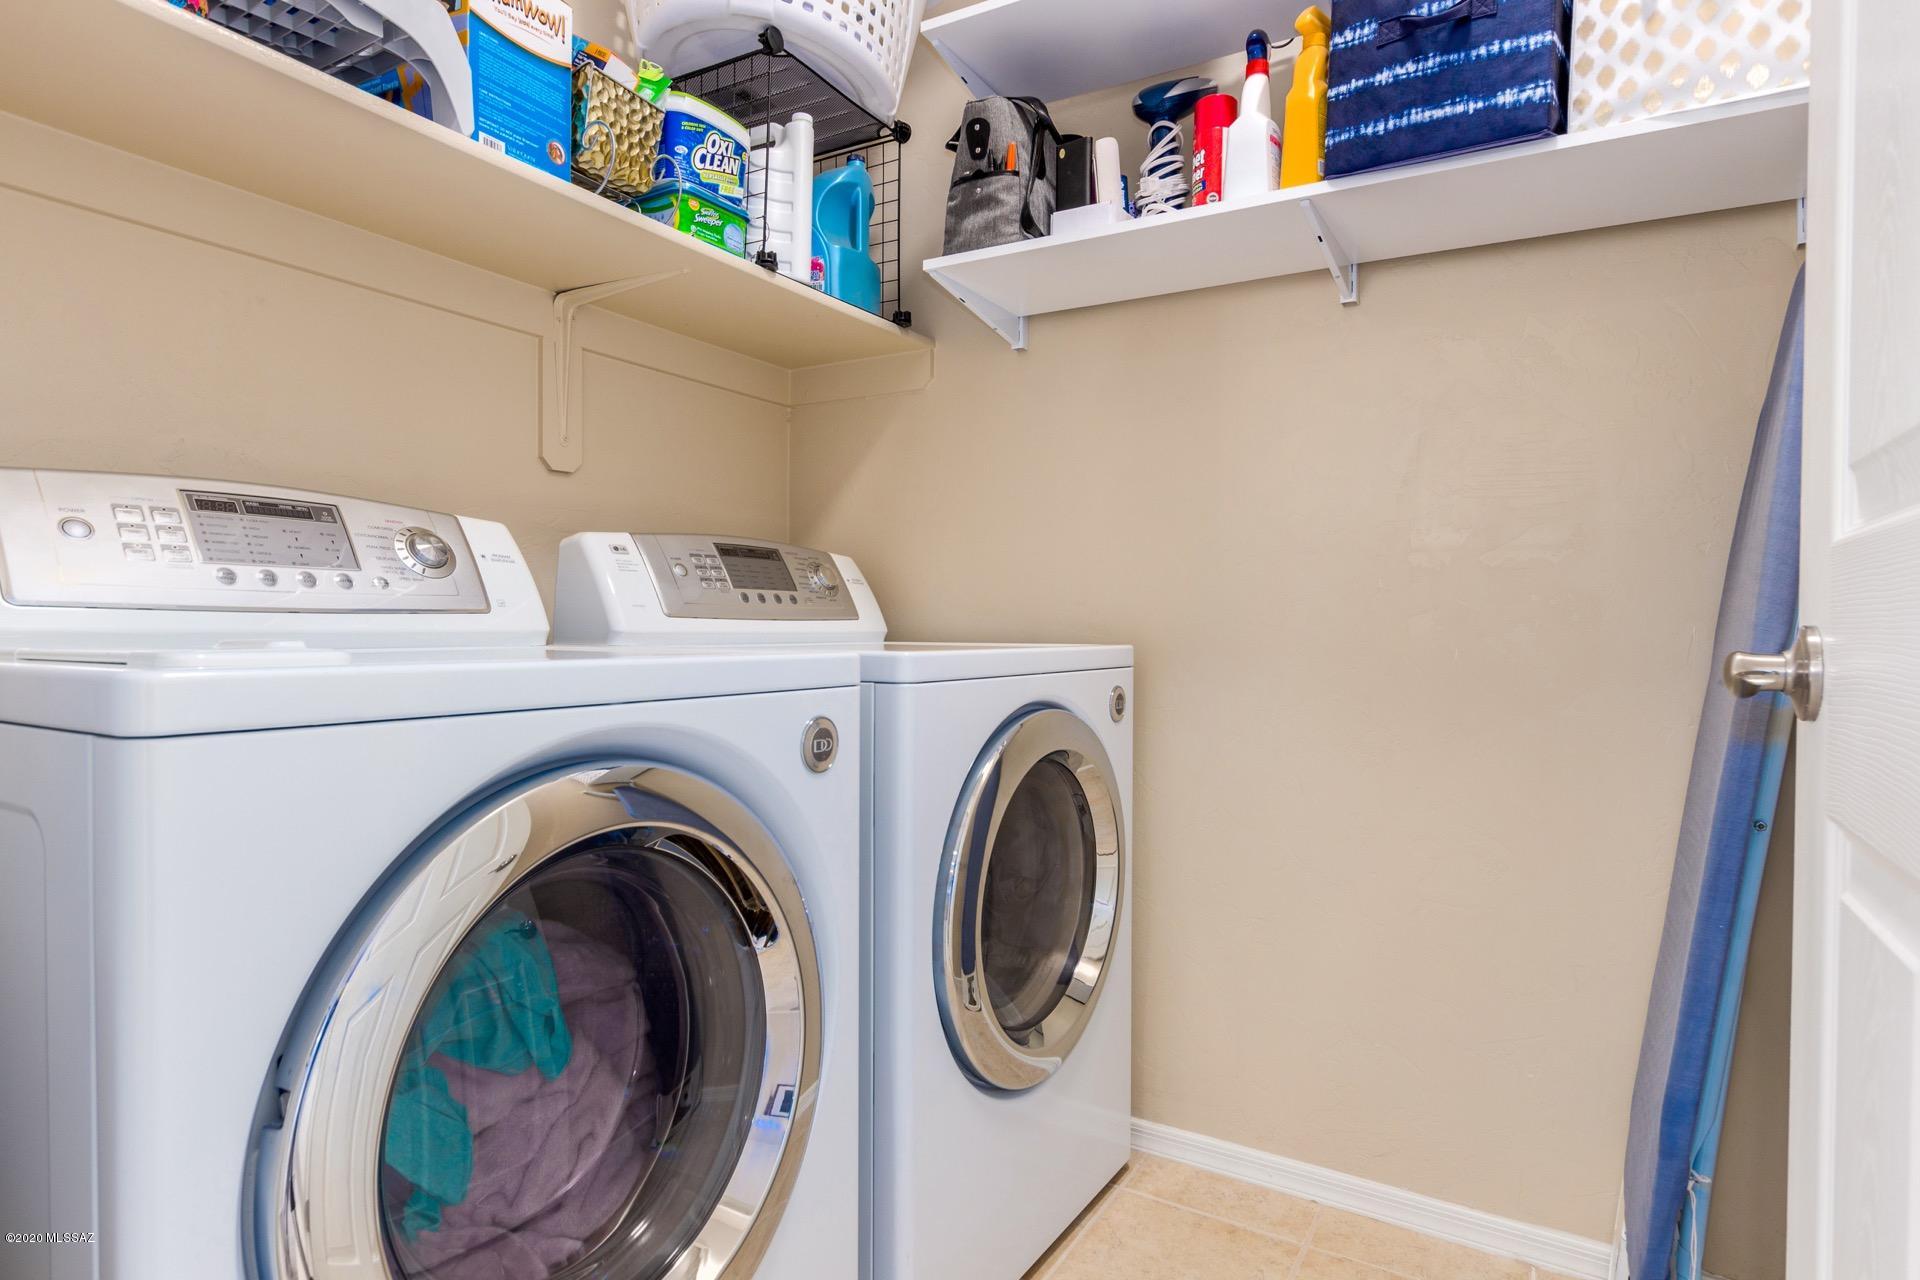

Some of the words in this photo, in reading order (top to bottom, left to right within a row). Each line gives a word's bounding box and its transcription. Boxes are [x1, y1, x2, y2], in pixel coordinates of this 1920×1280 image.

[705, 132, 734, 157] OXI
[693, 146, 740, 176] CLEAN
[693, 213, 724, 227] Sweeper
